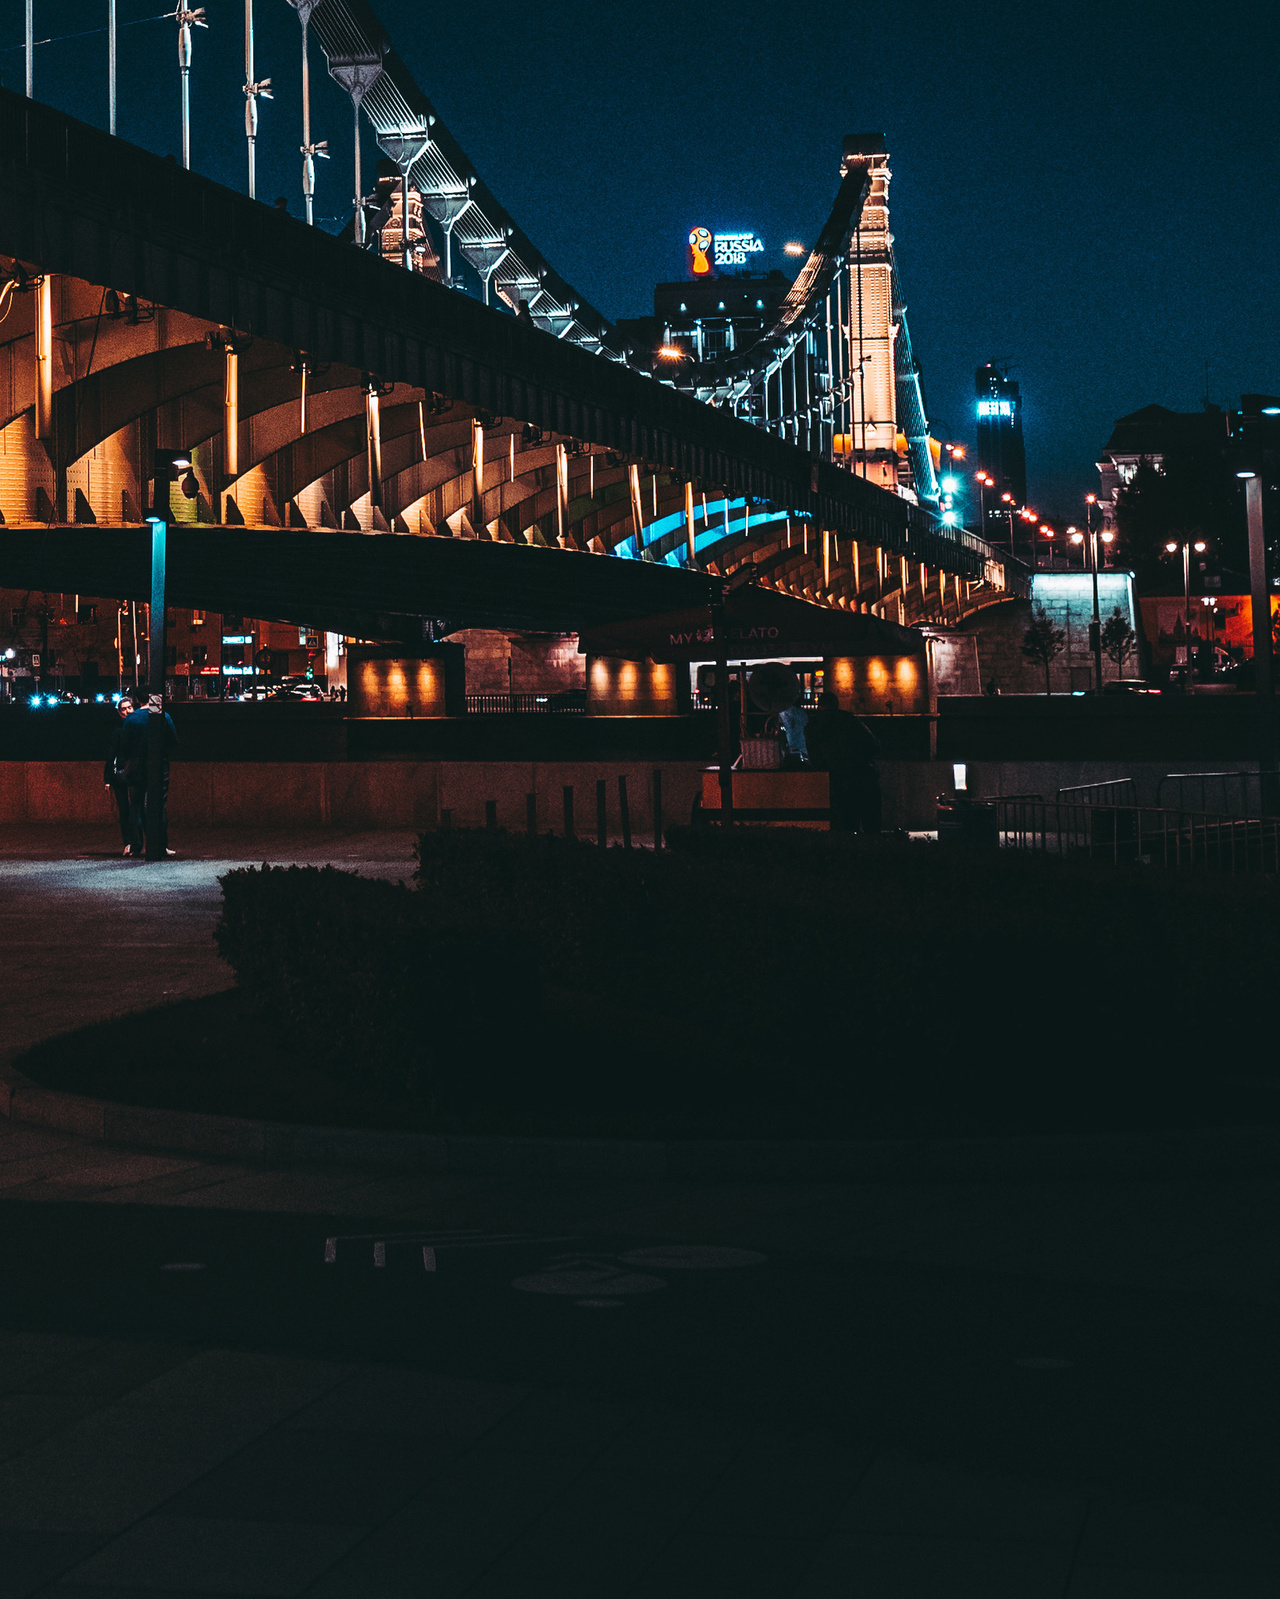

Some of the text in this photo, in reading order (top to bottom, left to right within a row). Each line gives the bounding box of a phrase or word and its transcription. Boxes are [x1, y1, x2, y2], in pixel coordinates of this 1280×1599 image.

[714, 238, 764, 253] RUSSIA
[714, 252, 747, 265] 2018
[669, 626, 779, 646] MY ELATO
